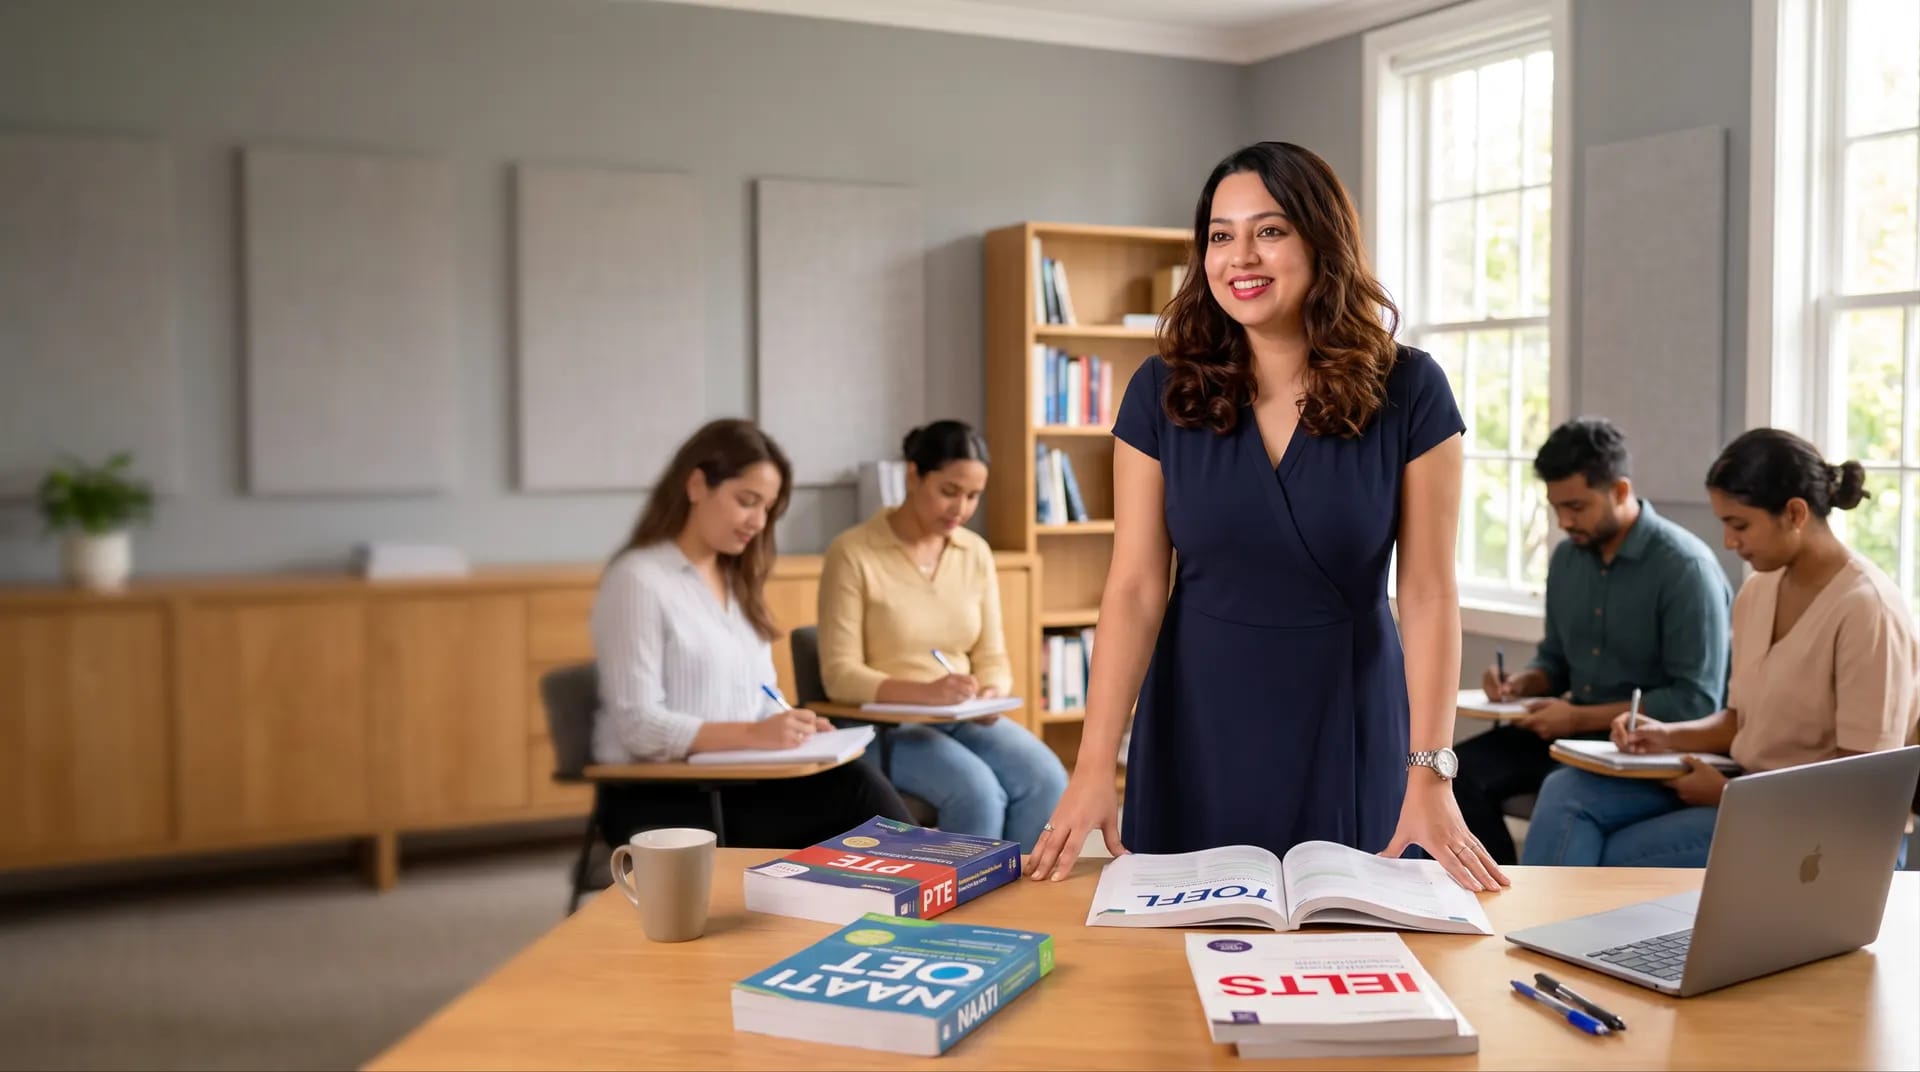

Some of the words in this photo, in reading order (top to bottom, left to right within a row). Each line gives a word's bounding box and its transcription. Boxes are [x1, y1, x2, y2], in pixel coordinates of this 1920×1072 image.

[827, 854, 914, 875] PTE
[922, 878, 953, 913] PTE
[1136, 884, 1274, 908] TOEFL
[820, 951, 985, 985] OET
[1217, 972, 1420, 997] IELTS
[762, 968, 957, 1010] NAATI
[957, 983, 999, 1033] NAATI
